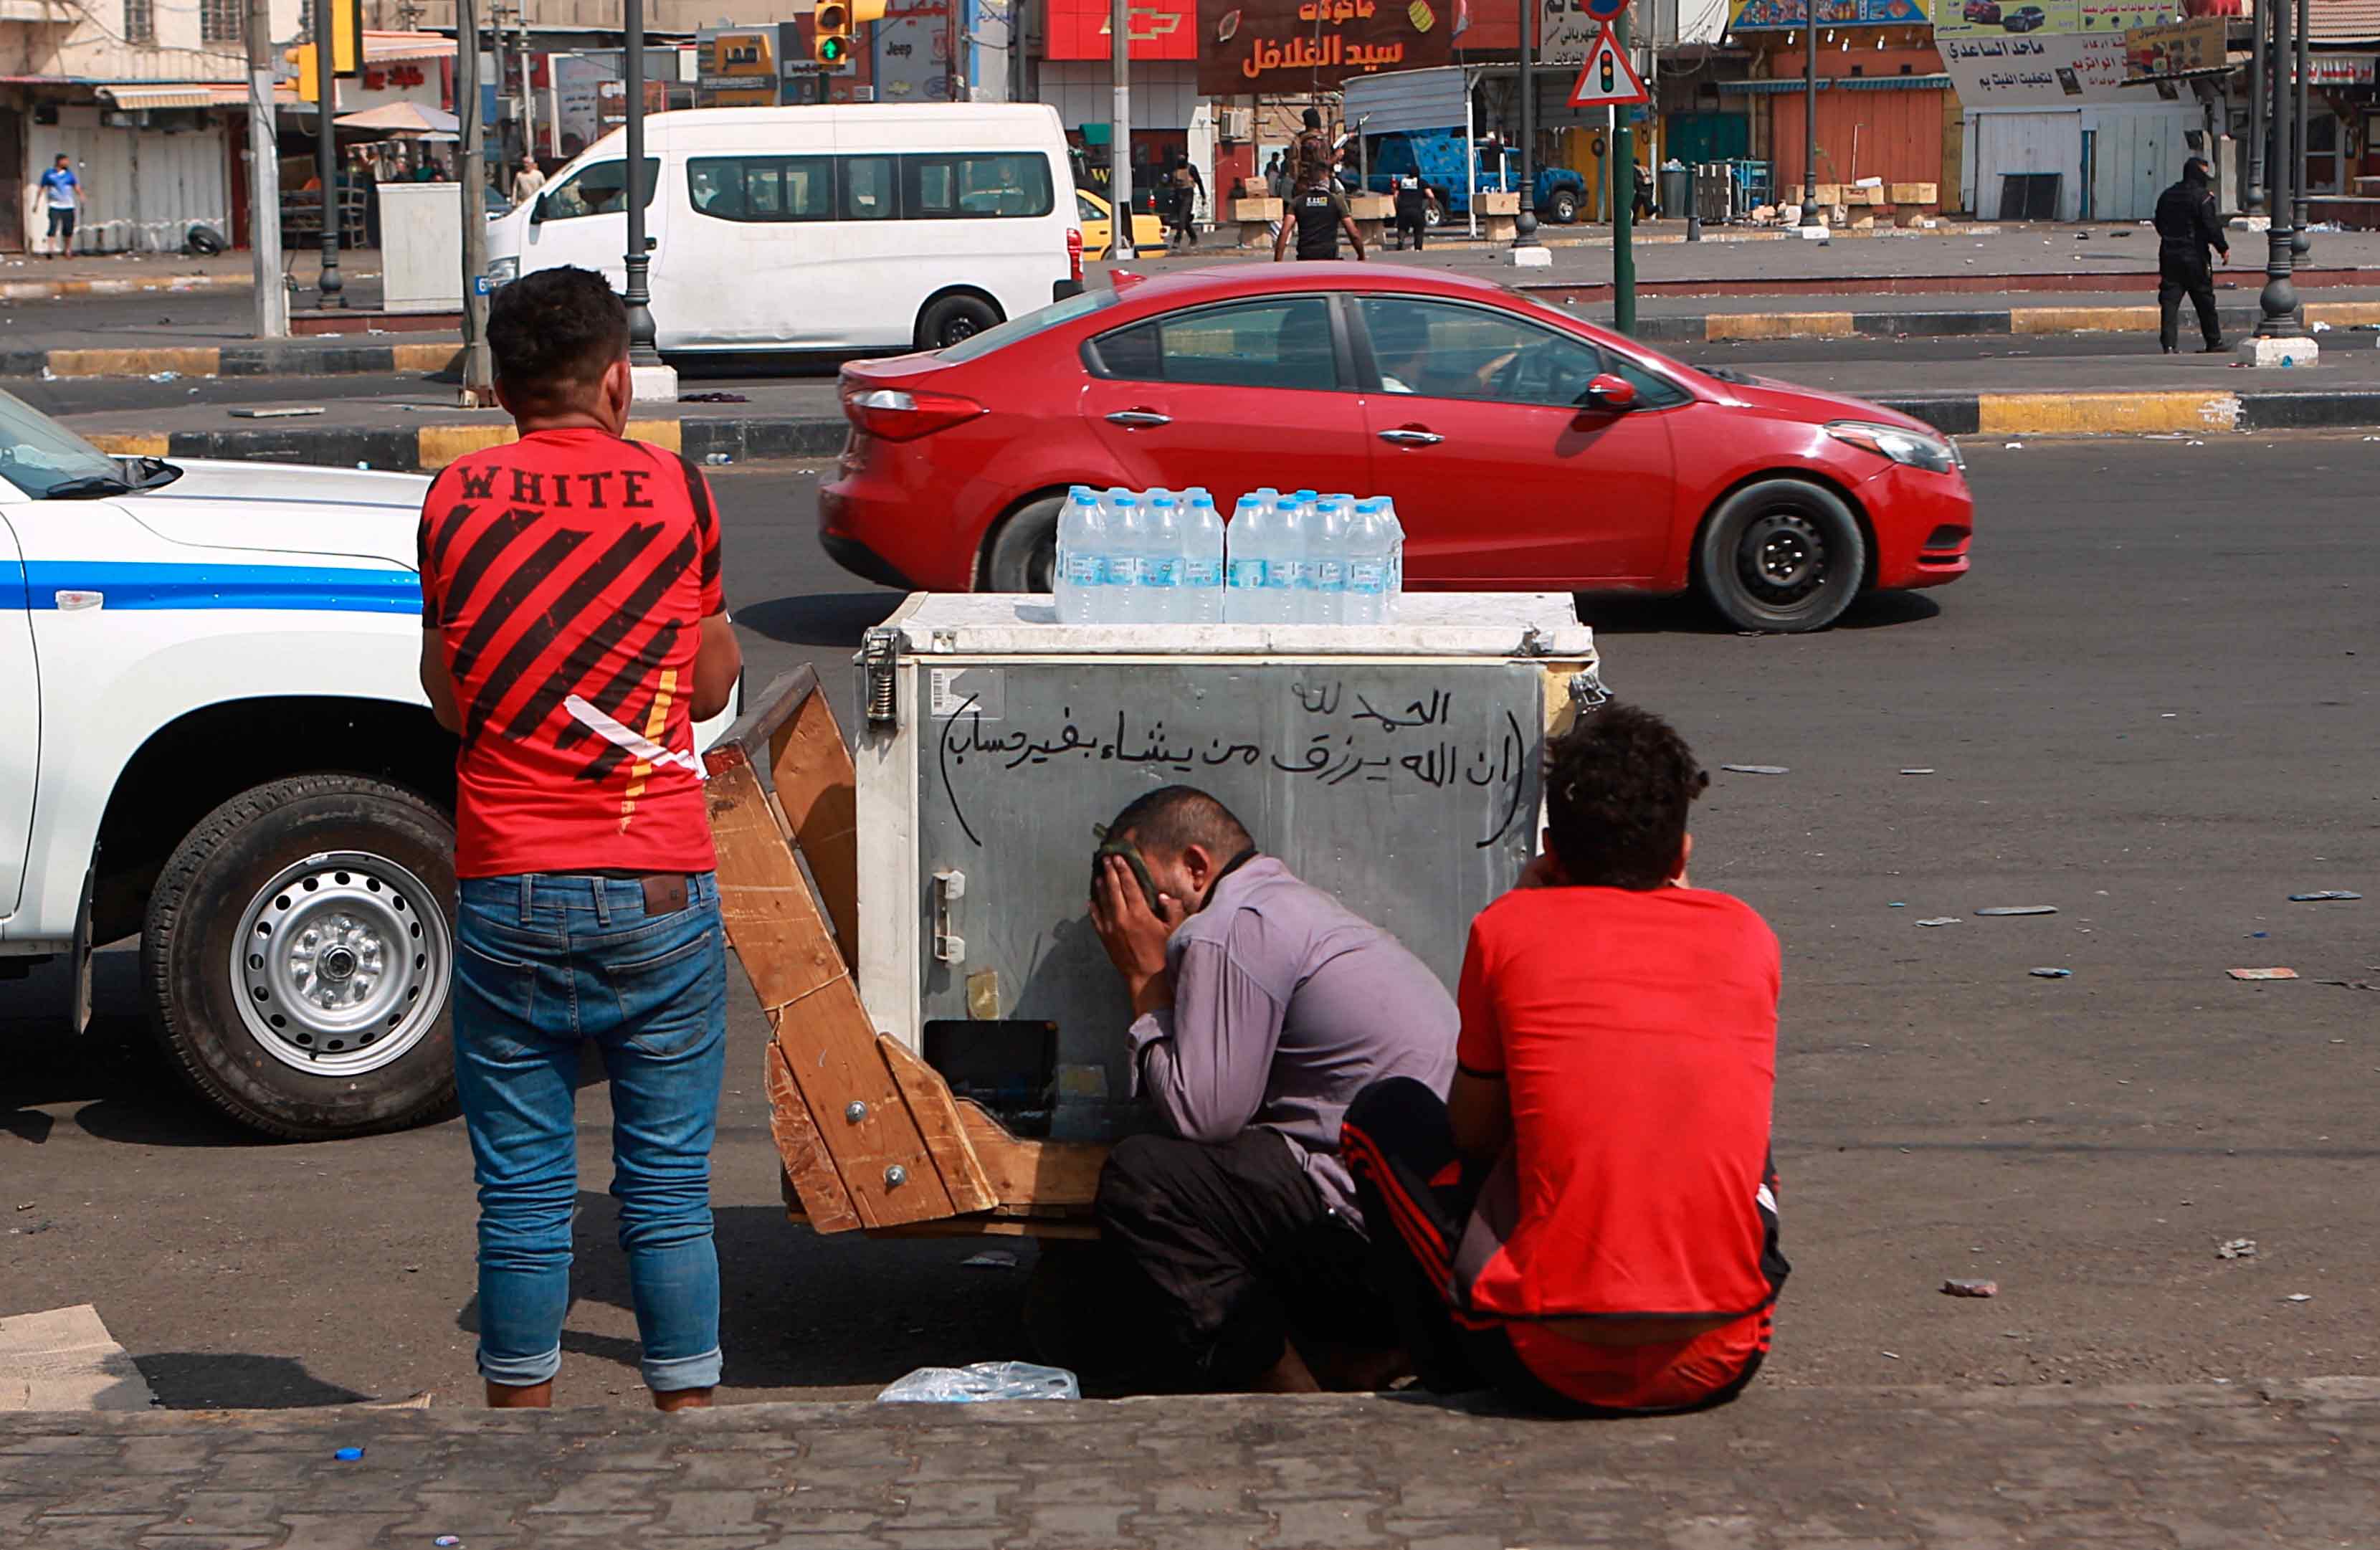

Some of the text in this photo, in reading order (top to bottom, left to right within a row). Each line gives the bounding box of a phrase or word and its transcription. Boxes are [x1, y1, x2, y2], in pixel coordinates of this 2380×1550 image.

[885, 41, 912, 58] Jeep
[1345, 42, 1403, 71] سيد
[1948, 39, 2045, 63] ماجد الساعدي
[457, 466, 654, 509] WHITE
[1290, 680, 1452, 733] الحمد لله
[1100, 710, 1194, 772] يشاء
[1202, 738, 1260, 766] من
[1271, 734, 1391, 786] يرزق
[1400, 741, 1457, 788] الله
